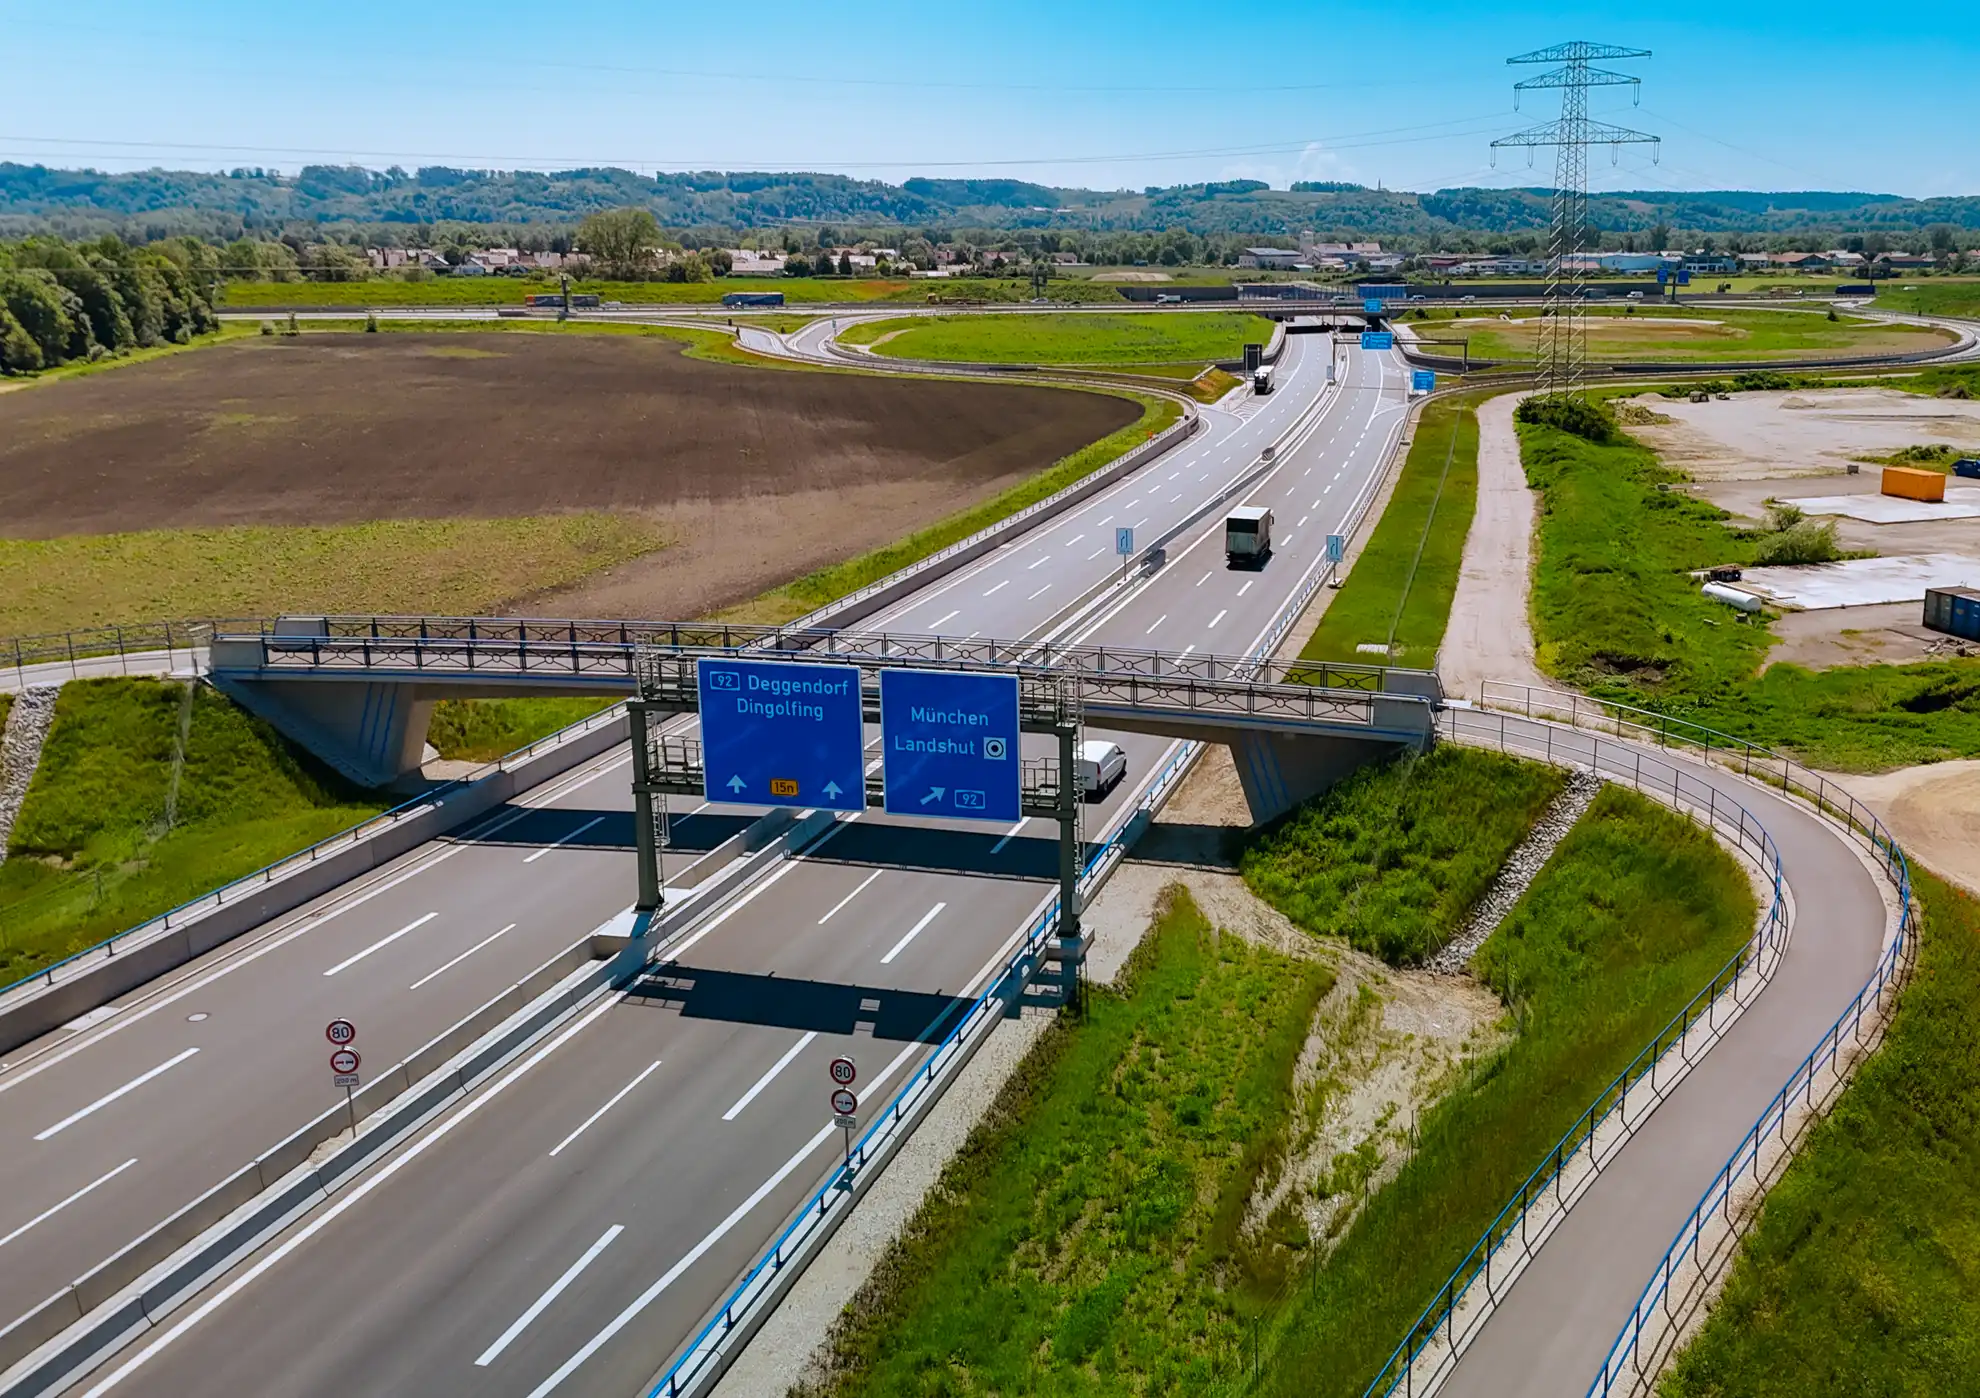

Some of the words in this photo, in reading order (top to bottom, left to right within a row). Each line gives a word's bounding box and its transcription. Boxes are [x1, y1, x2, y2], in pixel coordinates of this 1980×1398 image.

[717, 675, 733, 687] 92
[748, 675, 849, 696] Deggendorf
[737, 698, 823, 721] Dingolfing
[911, 706, 989, 726] München
[895, 735, 976, 755] Landshut
[775, 781, 794, 793] 15n
[962, 793, 977, 806] 92
[331, 1026, 349, 1039] 80
[835, 1065, 851, 1079] 80
